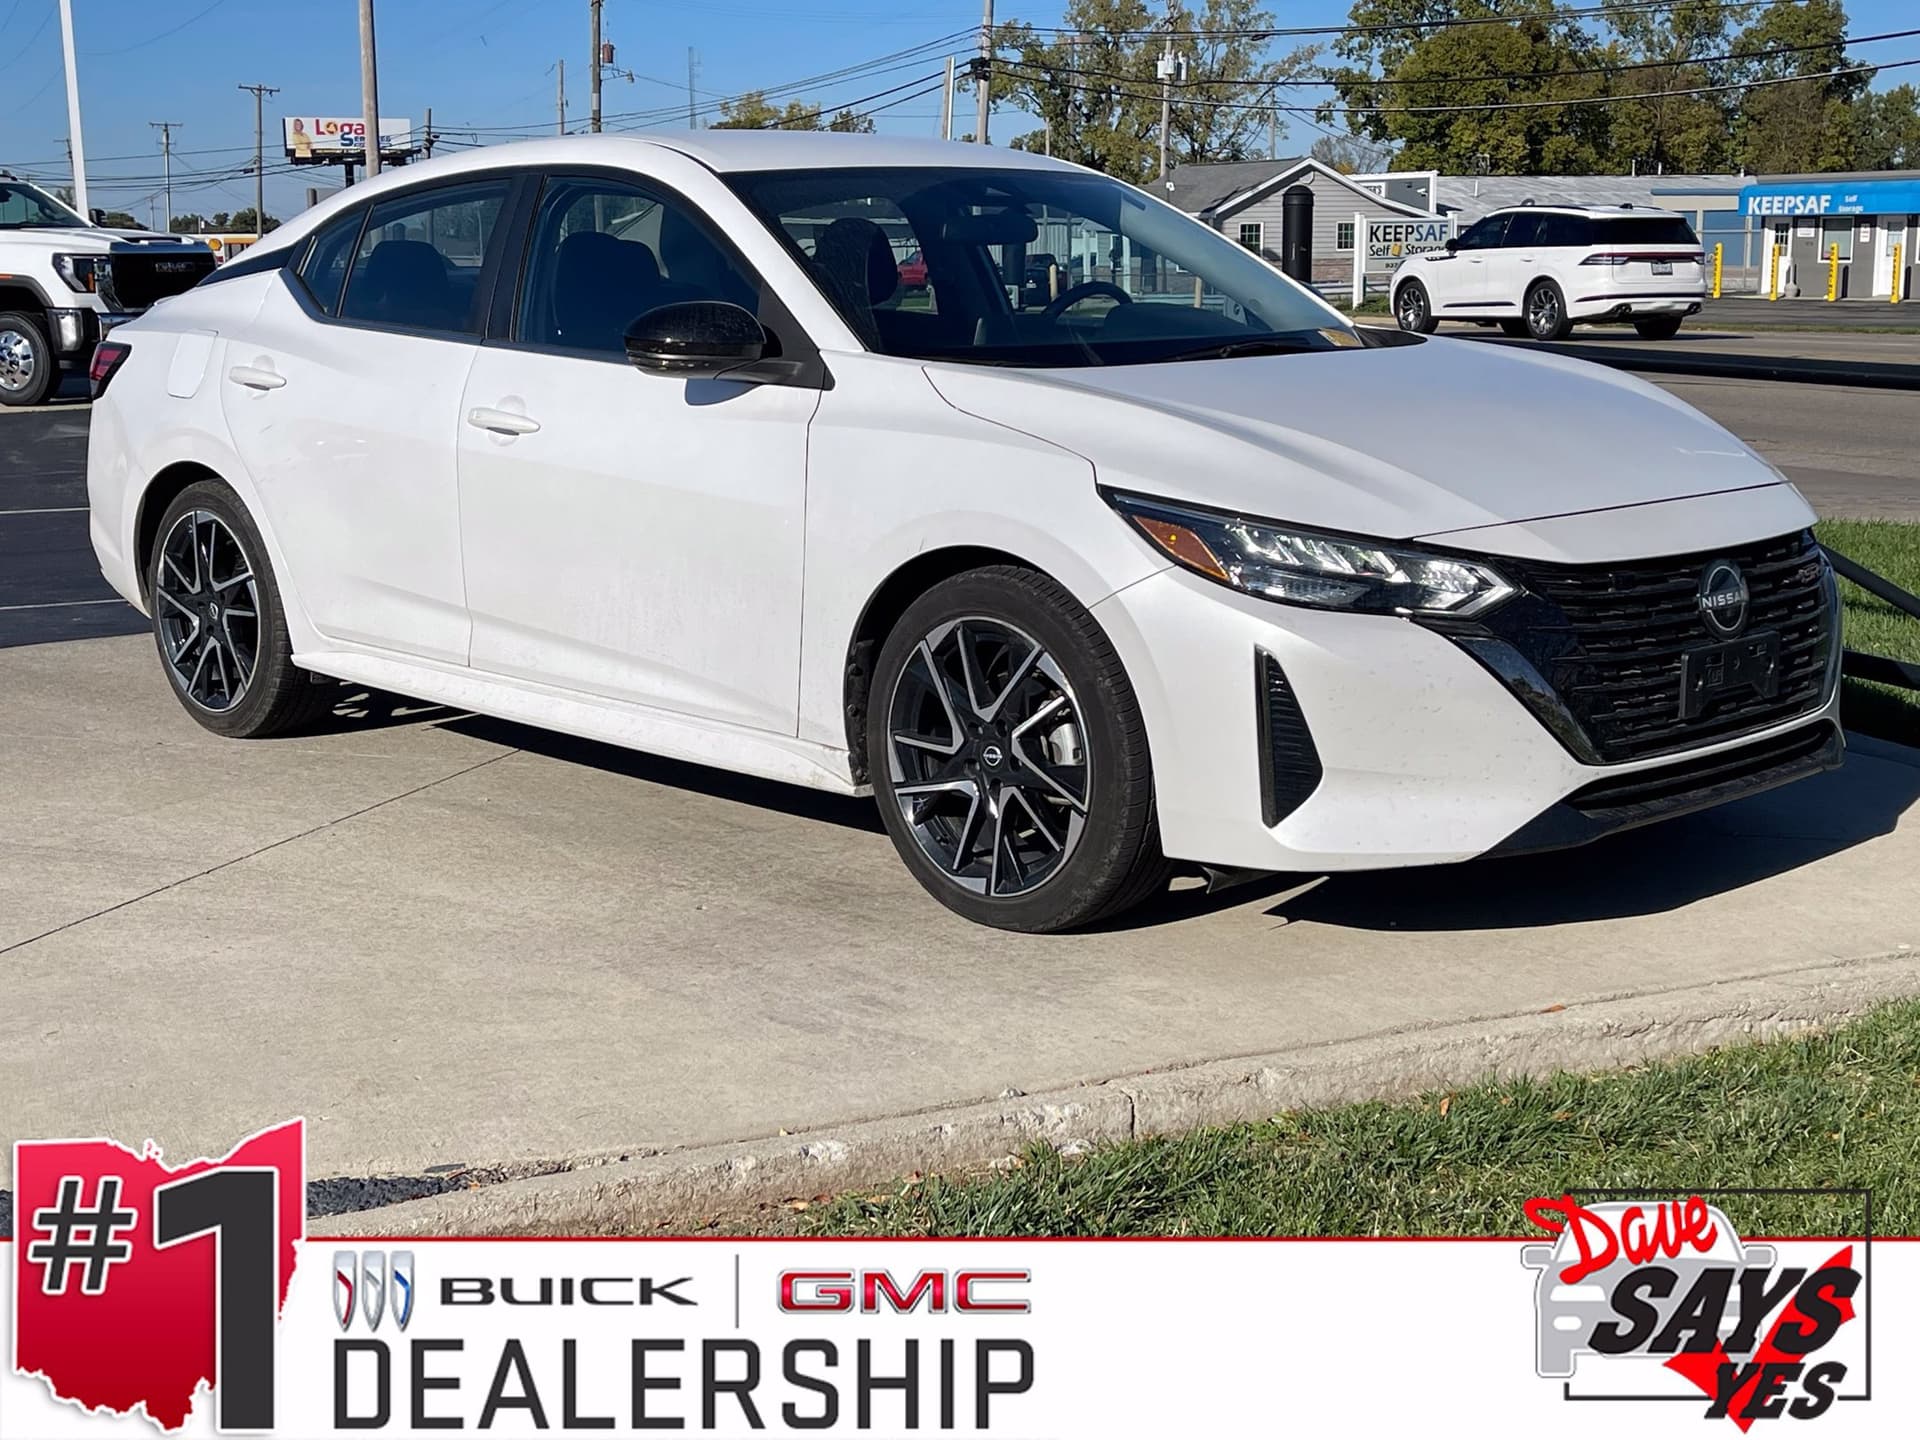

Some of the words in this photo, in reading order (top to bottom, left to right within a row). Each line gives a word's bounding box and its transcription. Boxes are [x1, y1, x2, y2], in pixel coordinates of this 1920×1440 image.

[315, 119, 365, 136] Loga
[1749, 194, 1831, 215] KEEPSAF
[1369, 224, 1448, 242] KEEPSAF
[1369, 244, 1391, 257] Self
[1405, 243, 1445, 255] Stora
[1702, 589, 1745, 609] NISSA
